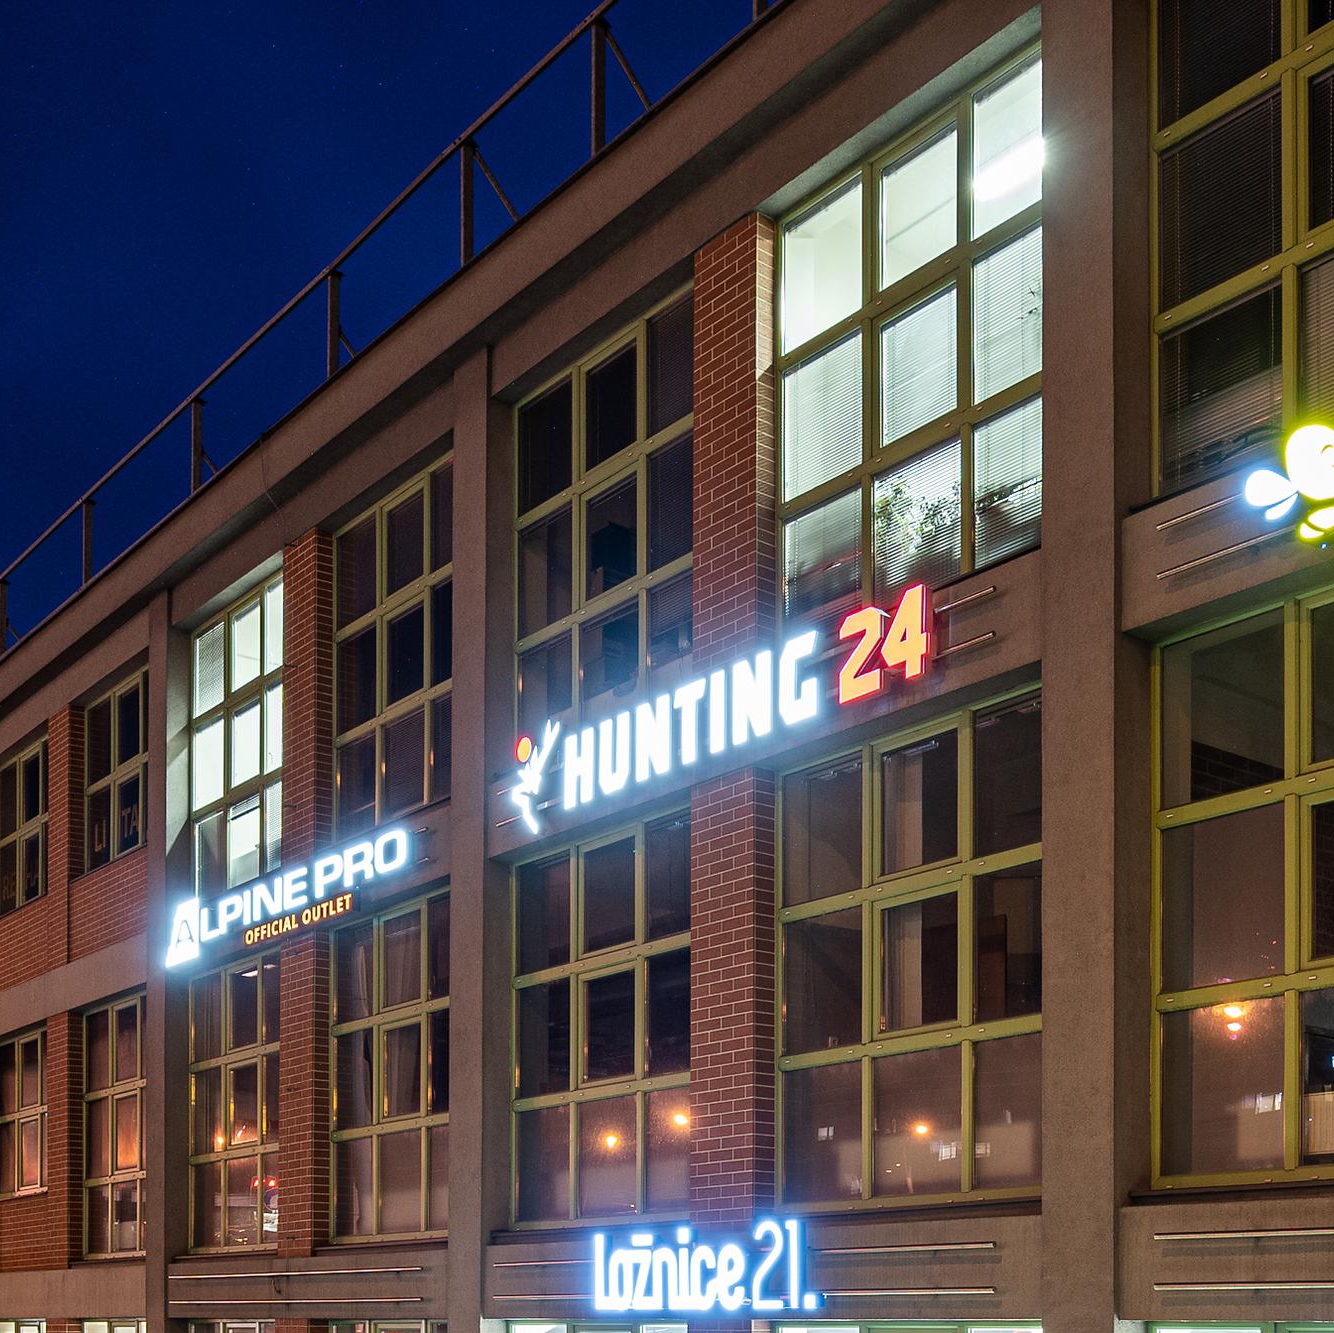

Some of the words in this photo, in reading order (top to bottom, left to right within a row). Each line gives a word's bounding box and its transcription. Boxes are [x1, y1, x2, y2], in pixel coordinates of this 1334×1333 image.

[562, 629, 820, 810] HUNTING
[837, 582, 933, 705] 24
[165, 866, 309, 968] ALPINE
[313, 828, 409, 899] PRO
[244, 913, 299, 945] OFFICIAL
[301, 892, 353, 926] OUTLET
[593, 1226, 746, 1311] Ložnice
[751, 1219, 818, 1310] 21.
